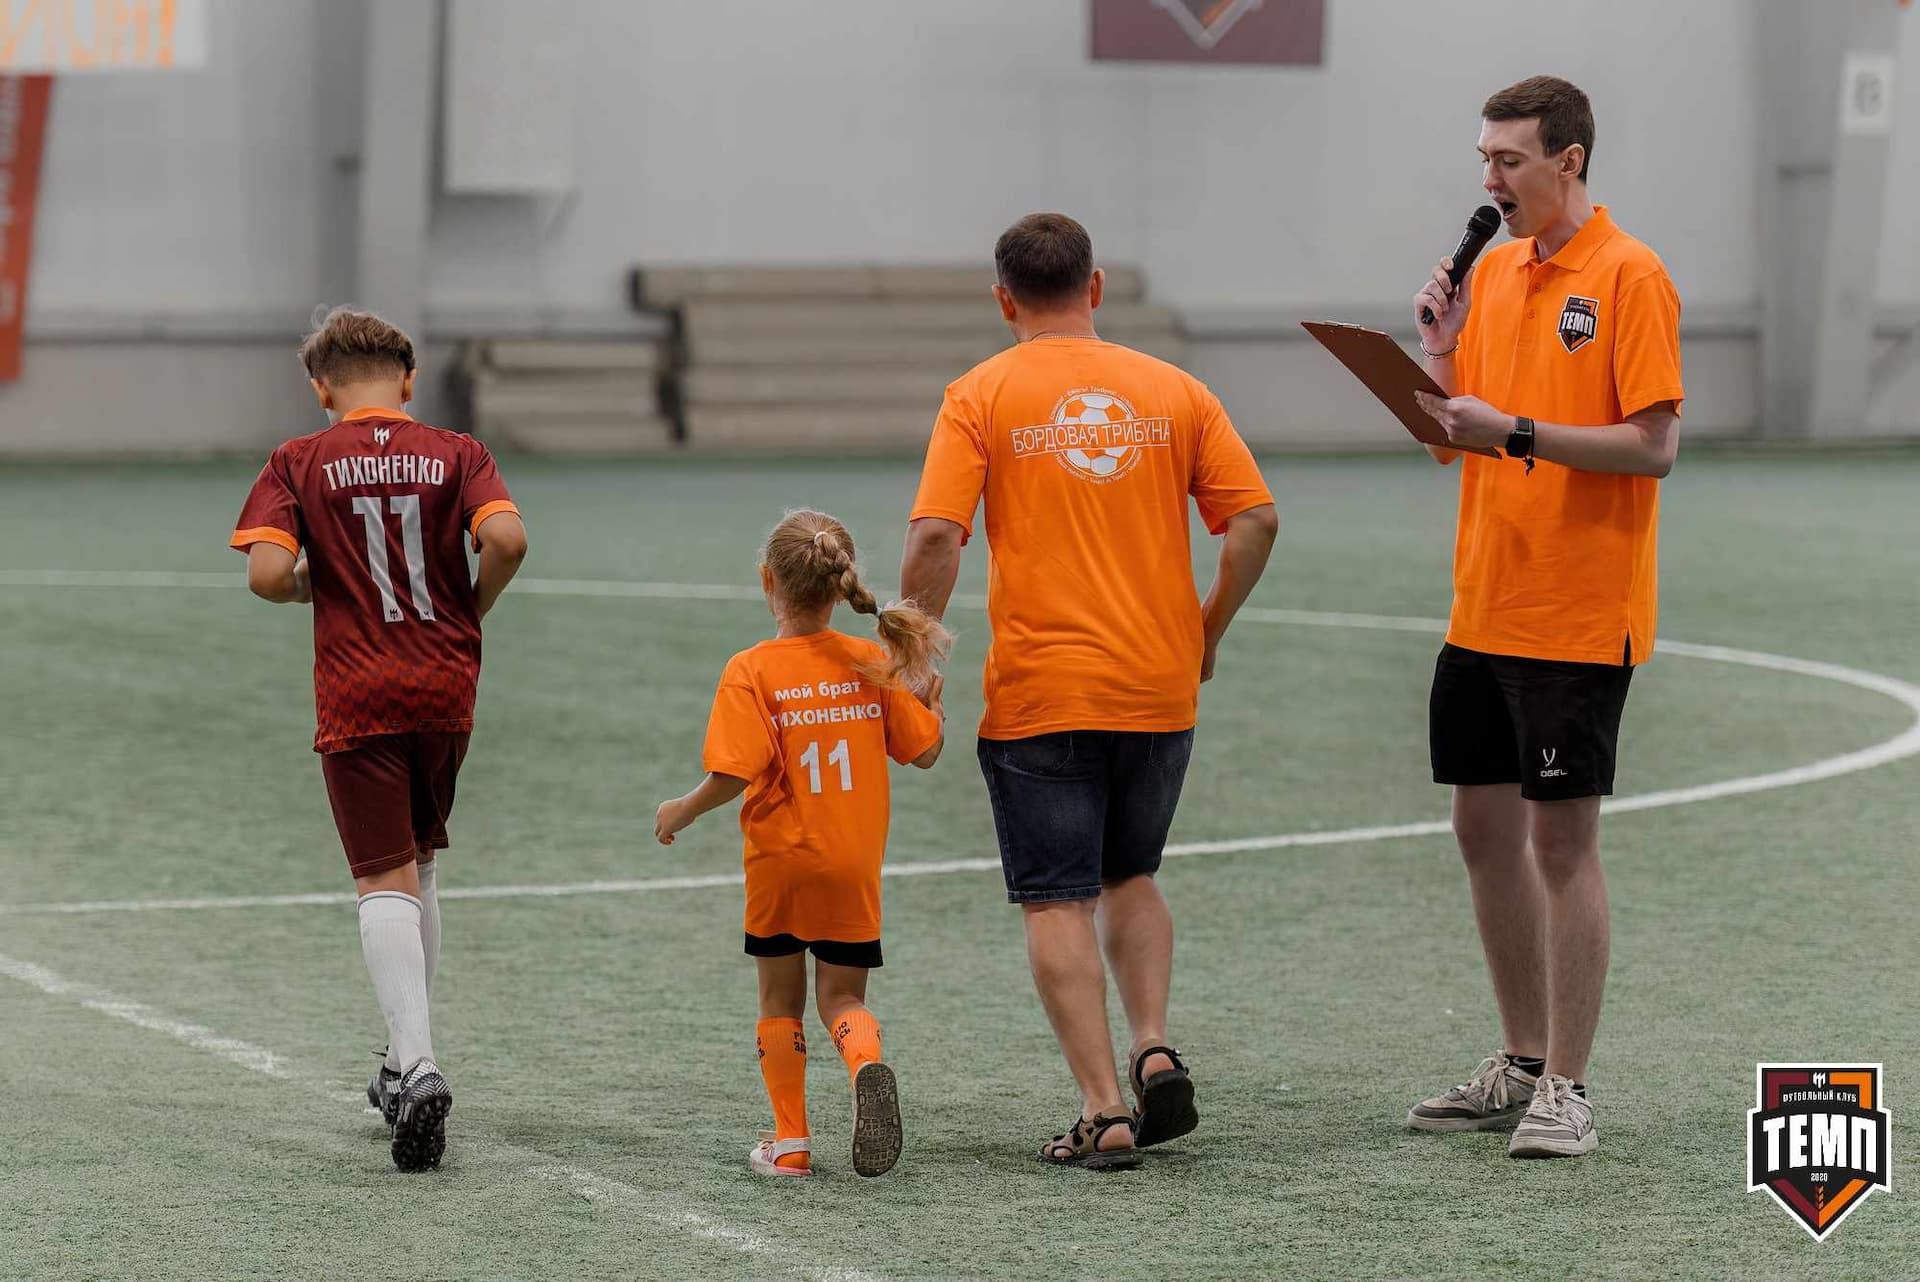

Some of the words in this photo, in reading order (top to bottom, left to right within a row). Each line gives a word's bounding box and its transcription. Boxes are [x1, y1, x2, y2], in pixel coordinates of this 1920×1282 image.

[1561, 311, 1595, 336] ТЕМП
[1012, 425, 1099, 453] БОРДОВАЯ
[1102, 420, 1170, 444] ТРИБУНА
[322, 454, 445, 491] ТИХОНЕНКО
[351, 494, 437, 623] 11
[774, 682, 814, 702] мой
[818, 679, 861, 699] брат
[800, 739, 853, 794] 11
